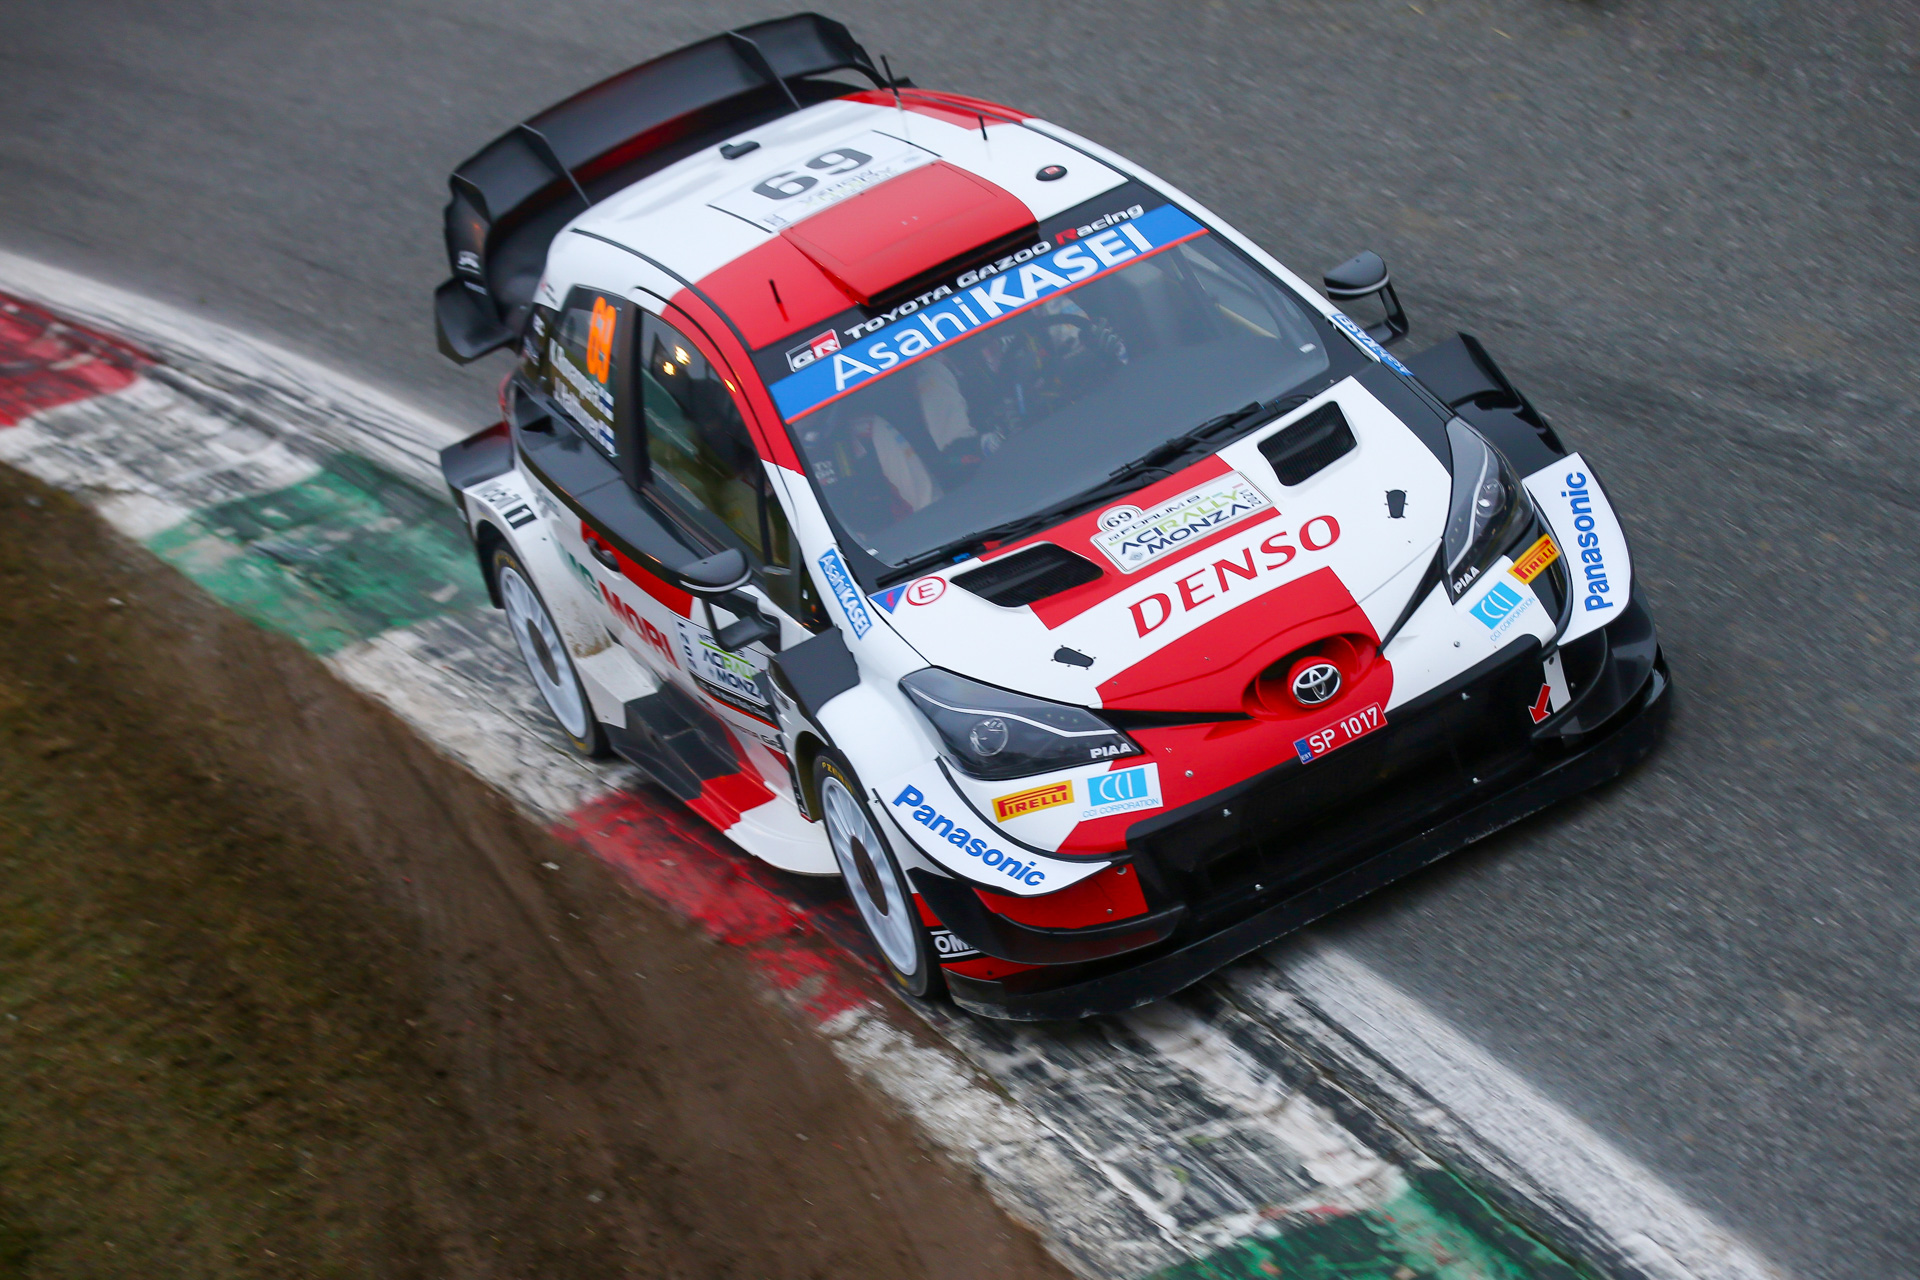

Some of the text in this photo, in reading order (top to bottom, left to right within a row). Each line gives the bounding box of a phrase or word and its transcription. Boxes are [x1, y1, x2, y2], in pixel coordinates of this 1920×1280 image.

[752, 148, 873, 200] 69
[791, 204, 1145, 371] GR TOYOTA GAZOO Racing
[832, 222, 1154, 391] AsahiKASEI
[1106, 511, 1133, 528] 69
[1146, 503, 1251, 555] MONZA
[1560, 471, 1614, 612] Panasonic
[1127, 514, 1341, 639] DENSO
[1452, 565, 1480, 595] PIAA
[1513, 538, 1557, 581] PIRELLI
[818, 554, 872, 636] AsahiKASEI
[917, 582, 937, 600] E
[716, 667, 763, 700] MONZ
[1089, 742, 1134, 759] PIAA
[1309, 706, 1378, 754] SP 1017
[997, 784, 1068, 818] PIRELLI
[891, 783, 1046, 887] Panasonic
[933, 932, 973, 953] OM
